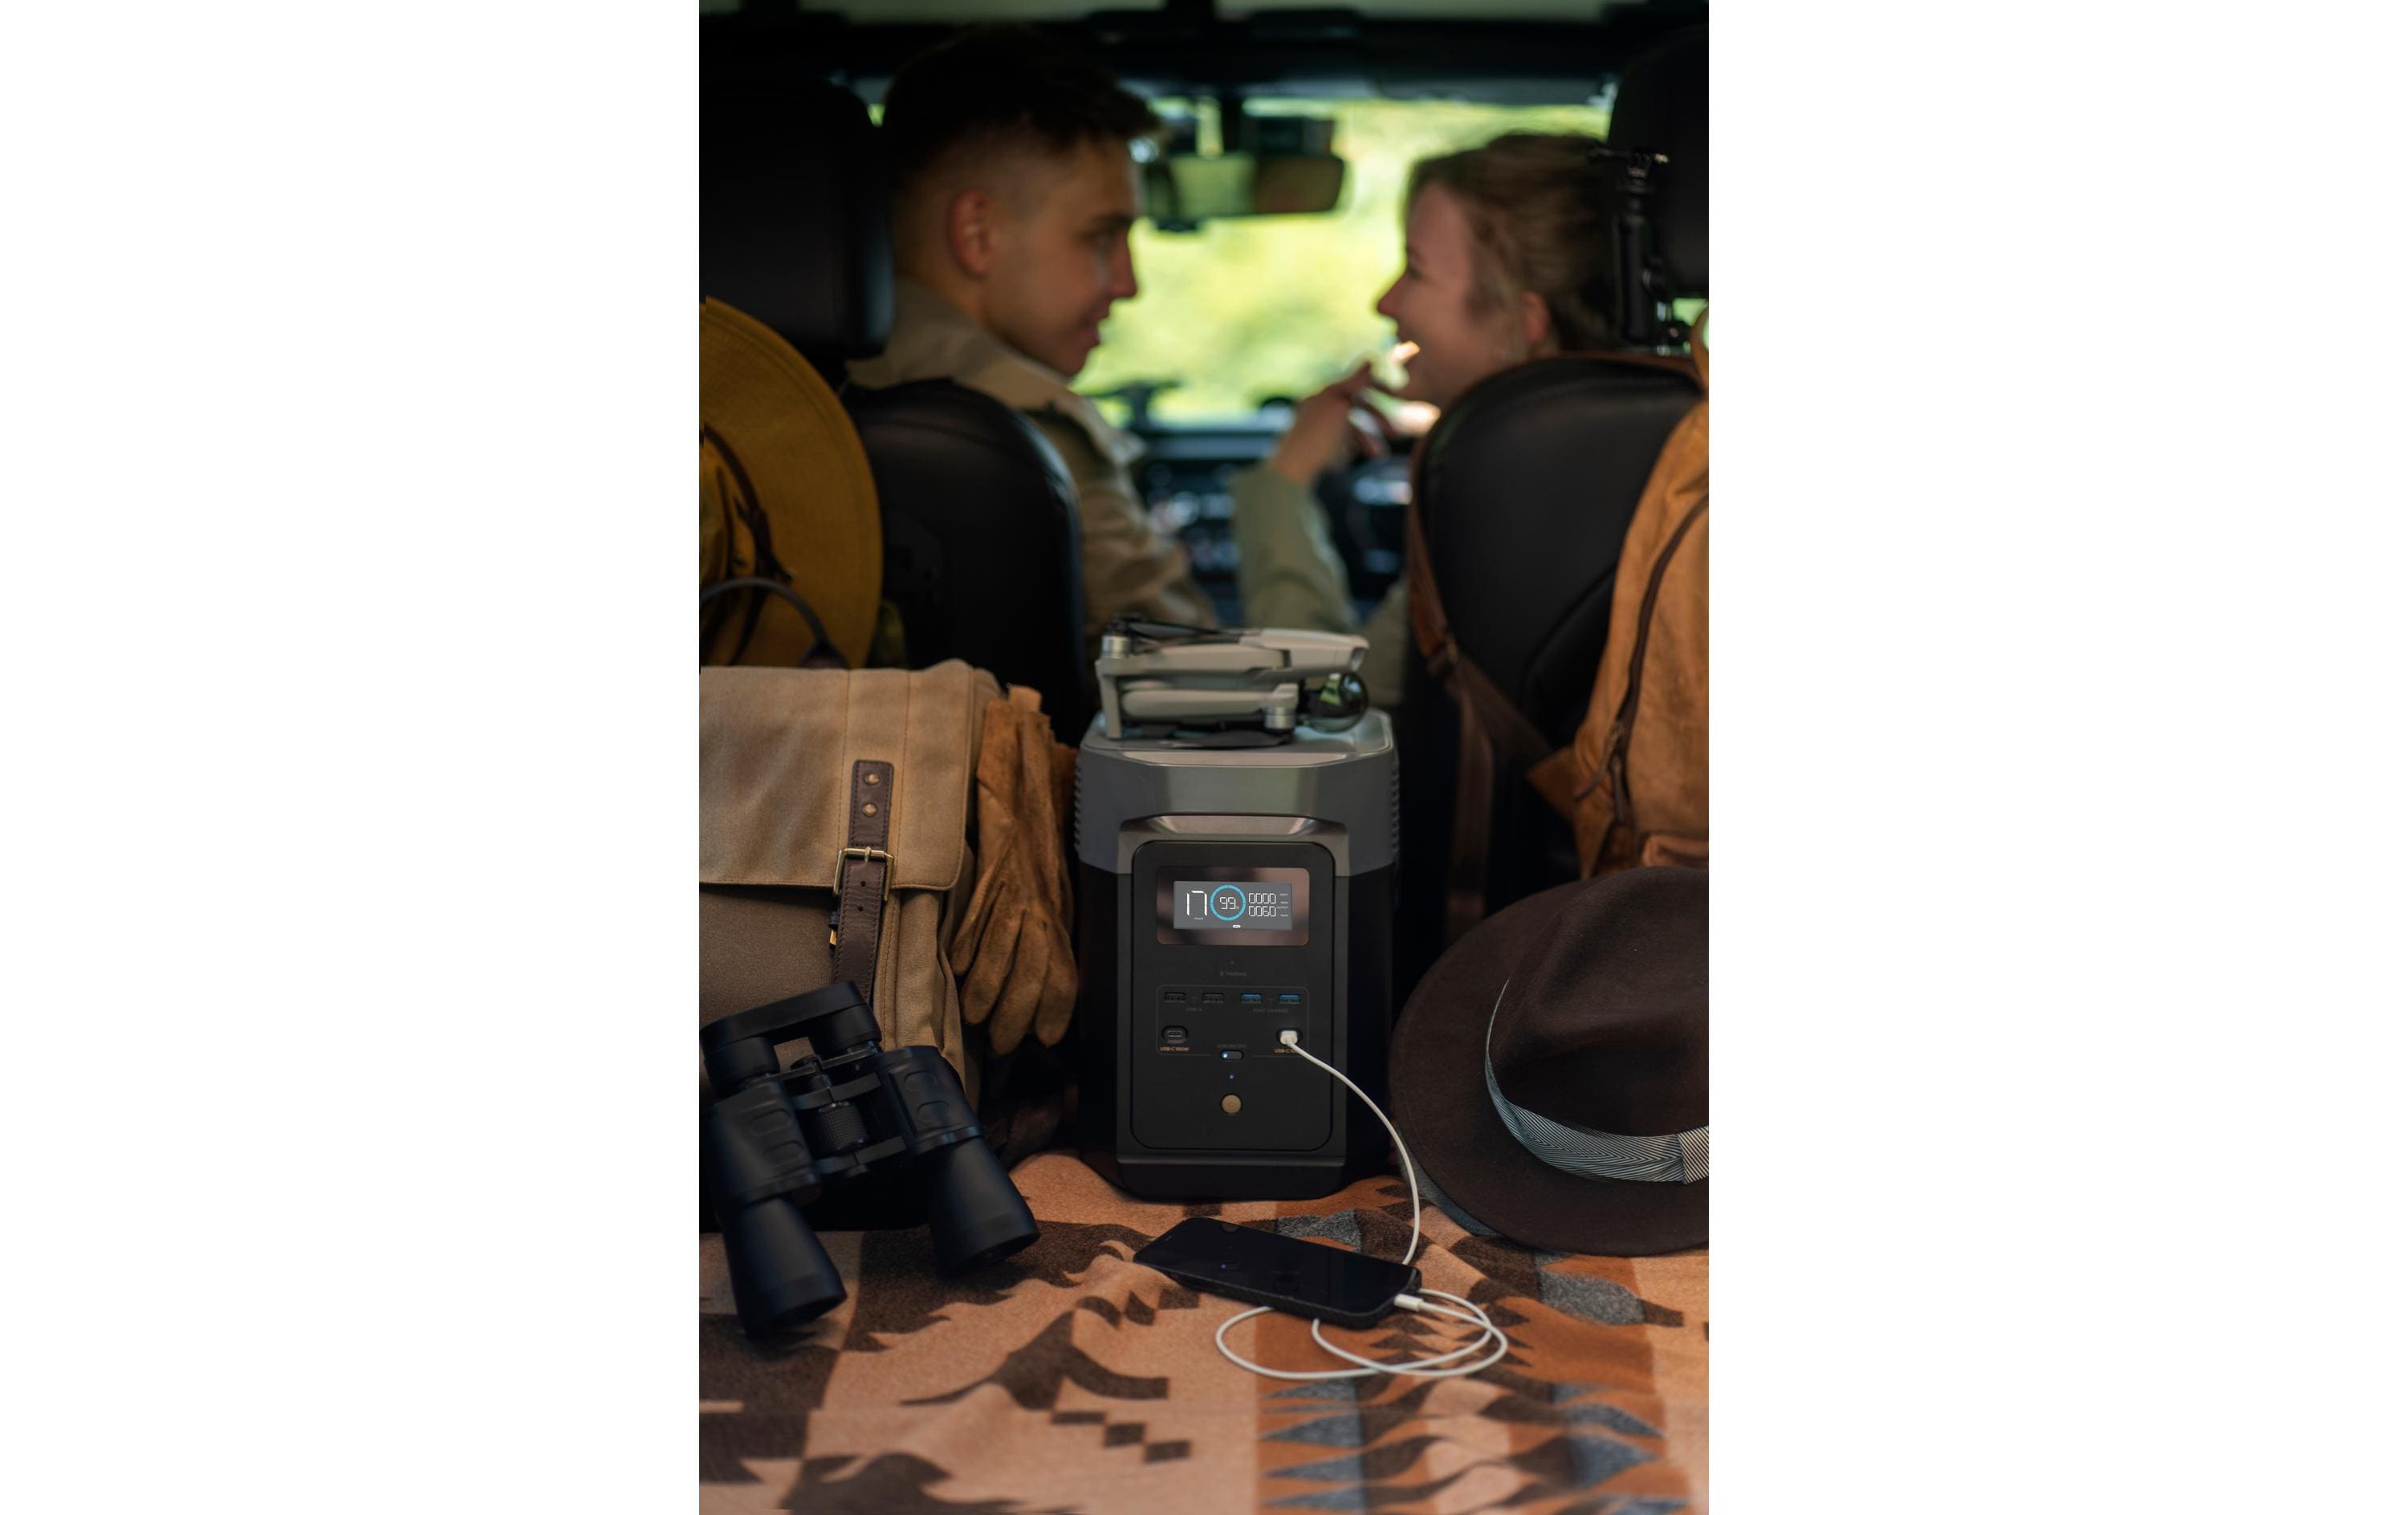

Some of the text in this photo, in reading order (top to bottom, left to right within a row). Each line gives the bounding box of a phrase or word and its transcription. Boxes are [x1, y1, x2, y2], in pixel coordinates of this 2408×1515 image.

[1186, 890, 1207, 916] 17
[1248, 892, 1276, 904] 0000
[1248, 905, 1276, 917] 0060
